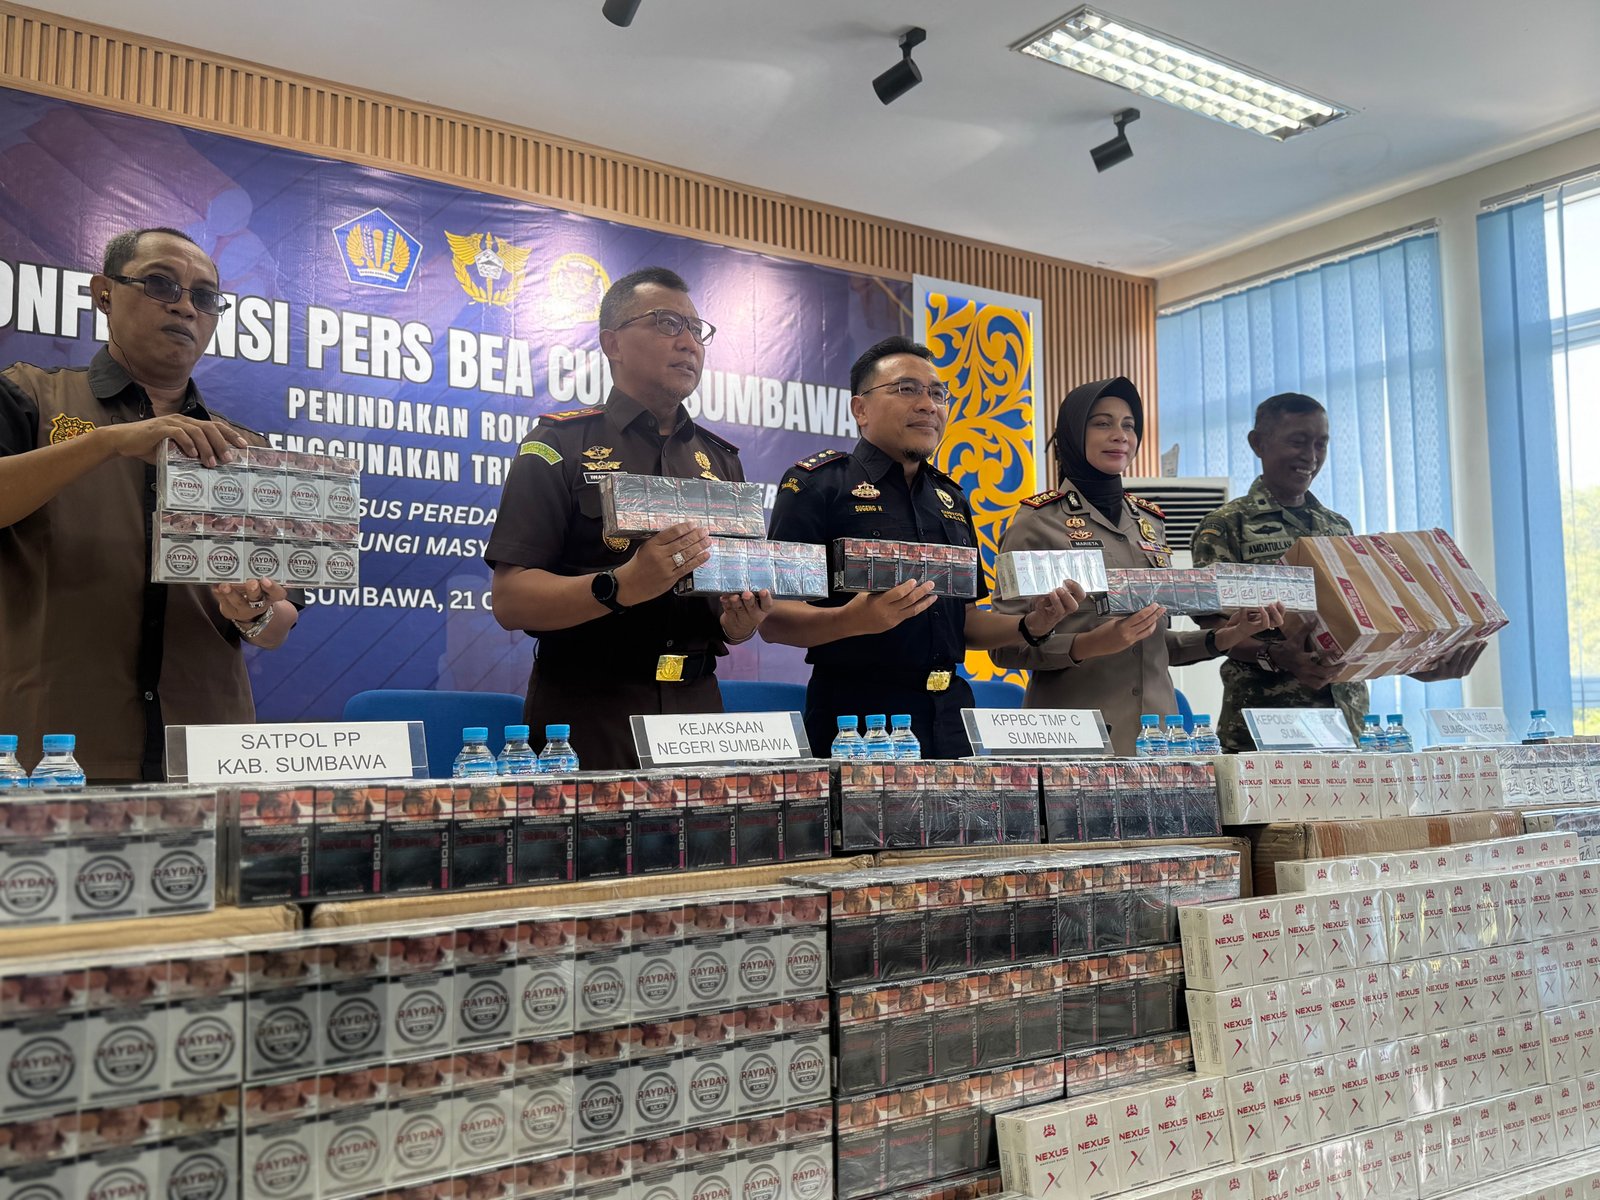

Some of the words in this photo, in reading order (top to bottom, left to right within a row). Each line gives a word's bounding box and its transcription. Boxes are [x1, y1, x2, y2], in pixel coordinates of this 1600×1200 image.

[307, 305, 434, 384] PERS
[449, 327, 535, 398] BEA
[288, 387, 469, 439] PENINDAKAN
[450, 590, 476, 610] 21
[991, 714, 1038, 726] KPPBC
[1039, 714, 1067, 726] TMP
[1071, 714, 1081, 726] C
[678, 721, 765, 735] KEJAKSAAN
[241, 732, 328, 750] SATPOL
[333, 732, 361, 747] PP
[1008, 732, 1078, 744] SUMBAWA
[657, 741, 715, 755] NEGERI
[718, 738, 793, 753] SUMBAWA
[217, 757, 268, 774] KAB.
[276, 754, 387, 773] SUMBAWA
[301, 836, 310, 874] BOLD
[441, 831, 449, 869] BOLD
[1531, 894, 1551, 902] NEXUS
[1555, 890, 1575, 899] NEXUS
[1505, 897, 1526, 907] NEXUS
[1449, 904, 1471, 914] NEXUS
[1322, 920, 1349, 930] NEXUS
[1357, 915, 1383, 926] NEXUS
[1252, 929, 1280, 940] NEXUS
[1288, 924, 1316, 935] NEXUS
[1215, 933, 1244, 945] NEXUS
[740, 959, 775, 971] RAYDAN
[787, 954, 821, 965] RAYDAN
[1562, 959, 1582, 970] NEXUS
[690, 964, 727, 977] RAYDAN
[1511, 967, 1532, 978] NEXUS
[638, 971, 676, 984] RAYDAN
[1456, 977, 1478, 988] NEXUS
[1484, 973, 1505, 984] NEXUS
[583, 980, 623, 993] RAYDAN
[1396, 986, 1420, 997] NEXUS
[1426, 981, 1449, 992] NEXUS
[524, 987, 566, 1000] RAYDAN
[1363, 992, 1388, 1003] NEXUS
[463, 994, 508, 1008] RAYDAN
[1329, 998, 1356, 1008] NEXUS
[398, 1004, 445, 1019] RAYDAN
[1295, 1003, 1322, 1015] NEXUS
[1260, 1010, 1288, 1023] NEXUS
[1224, 1017, 1253, 1030] NEXUS
[1549, 1034, 1569, 1044] NEXUS
[1575, 1028, 1594, 1038] NEXUS
[1492, 1045, 1513, 1056] NEXUS
[1520, 1040, 1540, 1050] NEXUS
[1435, 1057, 1457, 1068] NEXUS
[1464, 1052, 1486, 1062] NEXUS
[789, 1058, 824, 1071] RAYDAN
[1405, 1064, 1428, 1075] NEXUS
[740, 1066, 776, 1080] RAYDAN
[1375, 1070, 1399, 1081] NEXUS
[690, 1075, 727, 1090] RAYDAN
[1342, 1078, 1368, 1089] NEXUS
[637, 1085, 676, 1100] RAYDAN
[1309, 1085, 1335, 1096] NEXUS
[580, 1095, 622, 1110] RAYDAN
[1273, 1094, 1301, 1105] NEXUS
[523, 1104, 565, 1118] RAYDAN
[1237, 1102, 1266, 1114] NEXUS
[1557, 1106, 1577, 1116] NEXUS
[1196, 1109, 1224, 1121] NEXUS
[1530, 1113, 1551, 1123] NEXUS
[461, 1117, 505, 1132] RAYDAN
[1159, 1117, 1188, 1130] NEXUS
[1504, 1120, 1525, 1130] NEXUS
[398, 1128, 444, 1142] RAYDAN
[1119, 1127, 1150, 1139] NEXUS
[327, 1140, 377, 1157] RAYDAN
[1078, 1136, 1110, 1150] NEXUS
[1035, 1147, 1069, 1161] NEXUS
[255, 1154, 308, 1171] RAYDAN
[171, 1170, 225, 1185] RAYDAN
[793, 1168, 826, 1181] RAYDAN
[1327, 1168, 1351, 1181] NEXUS
[744, 1176, 780, 1190] RAYDAN
[1295, 1179, 1320, 1191] NEXUS
